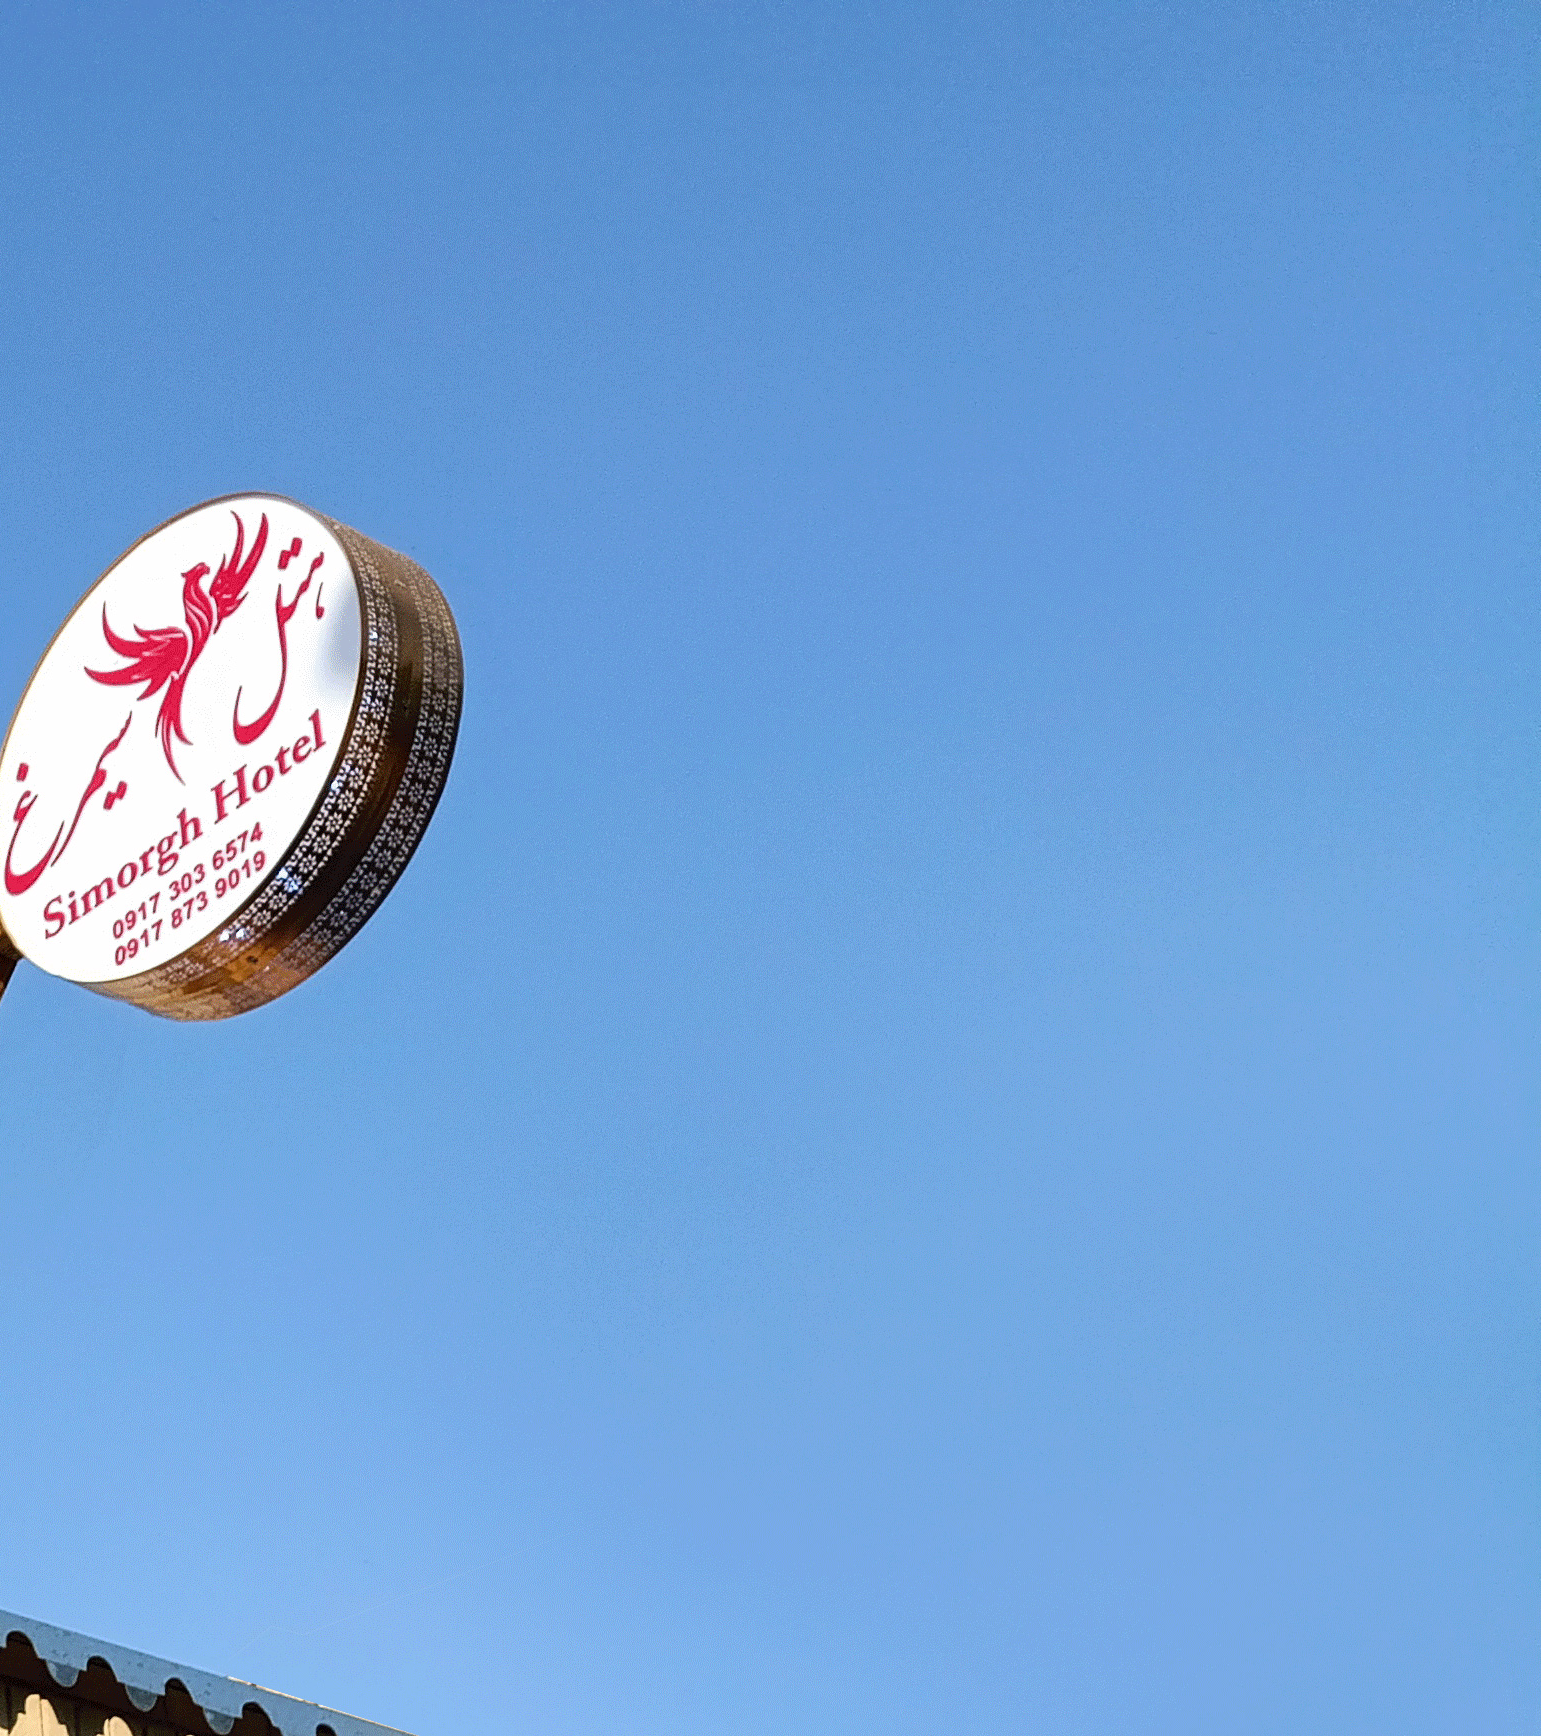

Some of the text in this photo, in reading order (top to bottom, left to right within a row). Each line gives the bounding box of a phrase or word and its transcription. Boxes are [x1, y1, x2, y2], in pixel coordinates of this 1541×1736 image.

[42, 708, 328, 940] Simorgh Hotel
[112, 821, 265, 940] 0917 303 6574
[114, 849, 268, 966] 0917 873 9019
